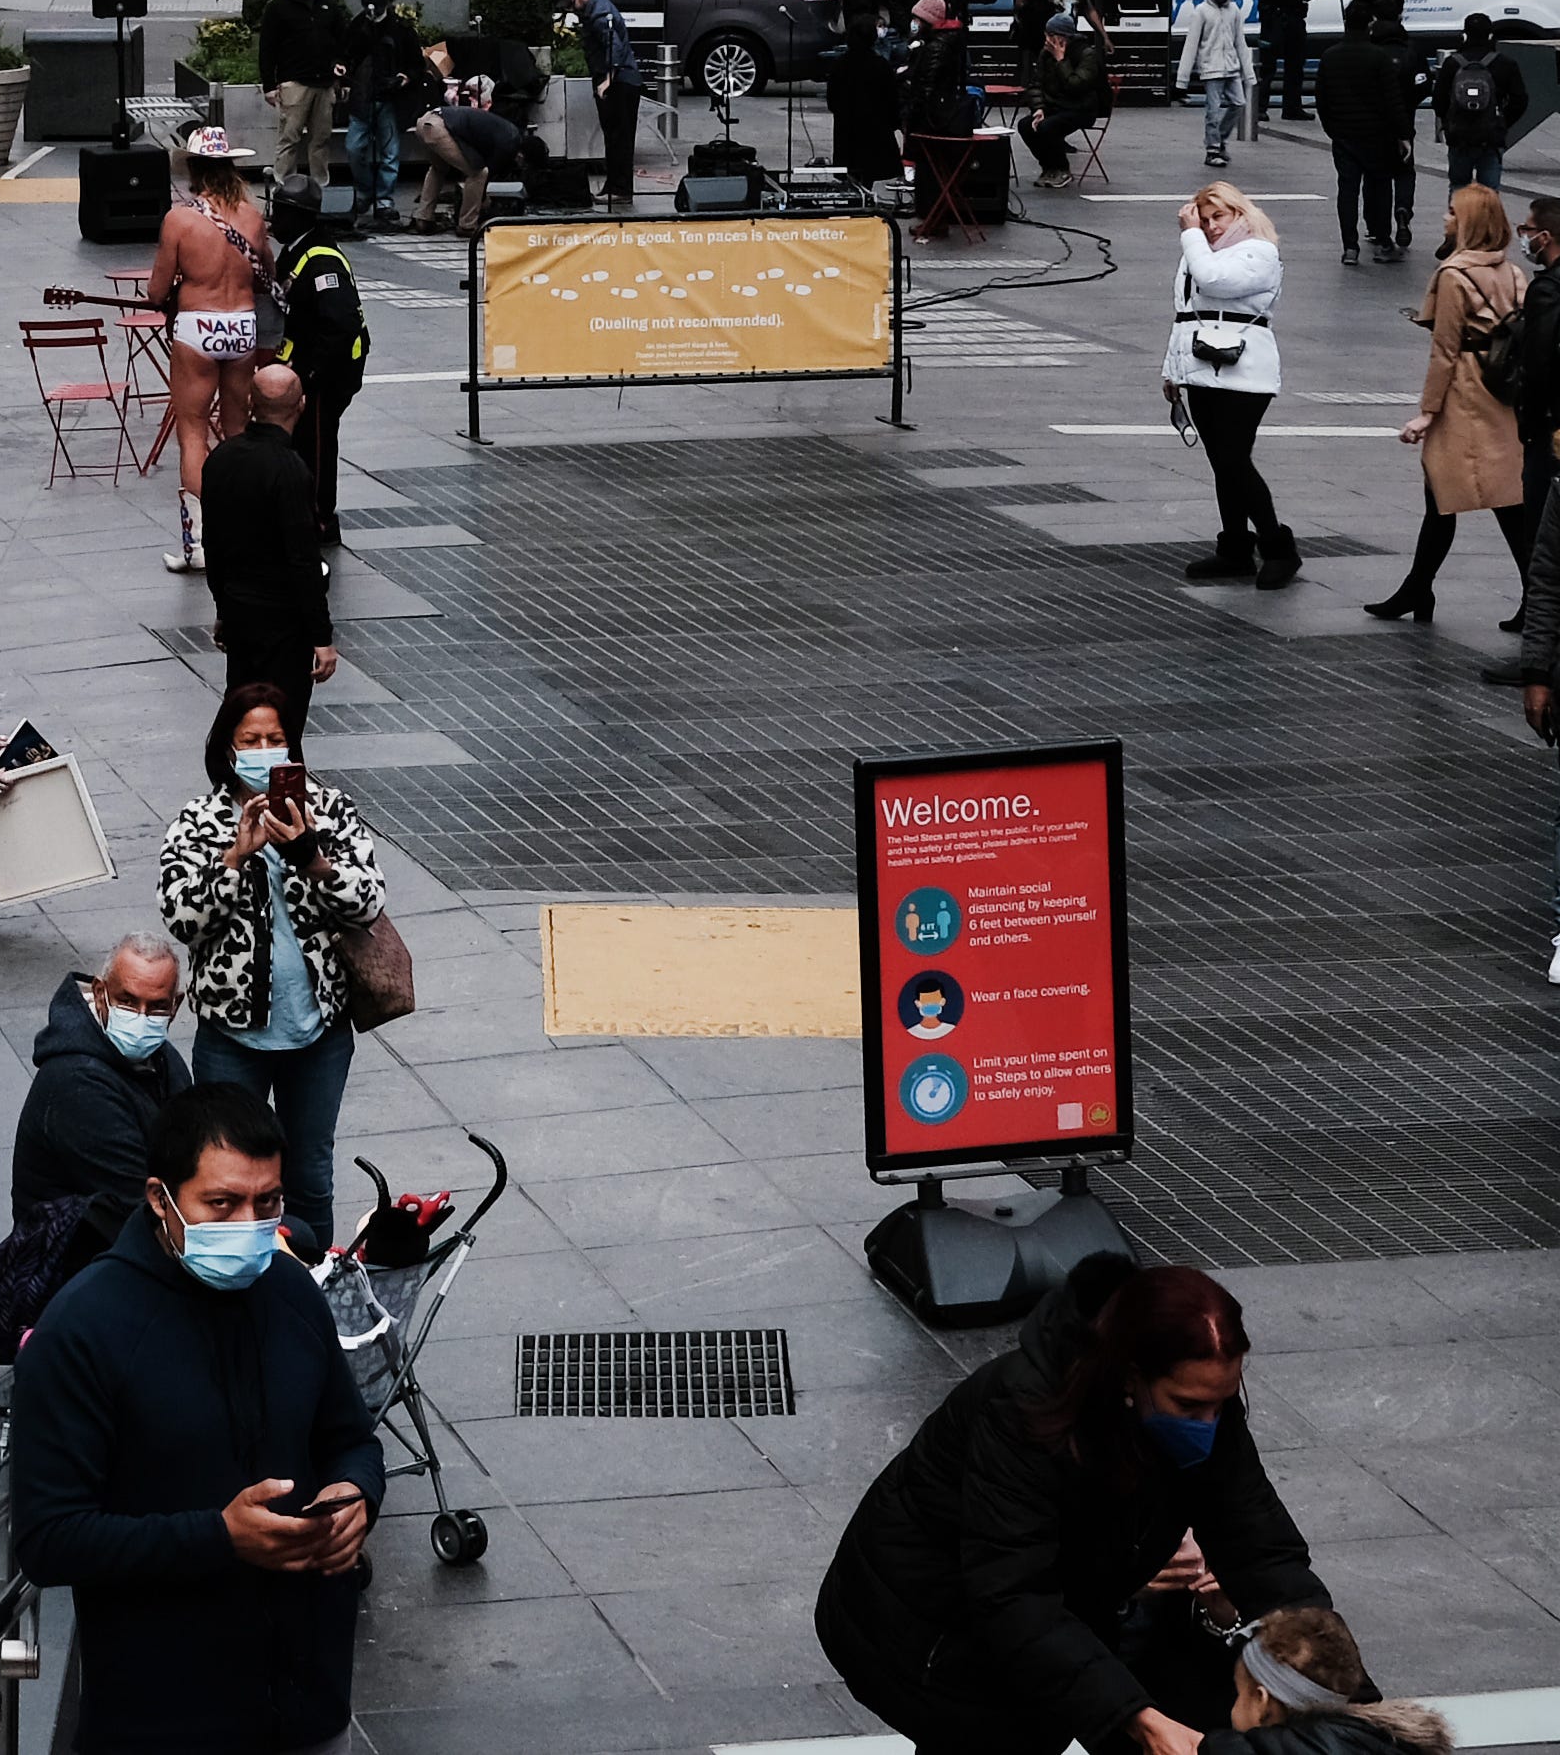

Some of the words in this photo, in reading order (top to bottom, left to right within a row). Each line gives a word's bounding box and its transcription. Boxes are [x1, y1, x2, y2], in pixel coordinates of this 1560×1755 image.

[528, 234, 549, 247] Six
[552, 233, 580, 246] feet
[583, 233, 618, 247] away
[621, 231, 634, 244] is
[637, 231, 676, 247] good.
[680, 230, 703, 243] Ten
[707, 231, 748, 245] paces
[751, 229, 763, 242] is
[766, 231, 798, 242] even
[803, 228, 847, 242] better.
[589, 317, 648, 333] (Dueling
[652, 316, 675, 329] not
[678, 313, 784, 330] recommended).
[881, 794, 1039, 828] Welcome.
[968, 885, 1016, 898] Maintain
[1019, 881, 1052, 894] social
[968, 899, 1026, 915] distancing
[1027, 899, 1040, 911] by
[1043, 895, 1087, 908] keeping
[969, 919, 977, 930] 6
[980, 917, 1001, 929] feet
[1004, 912, 1051, 928] between
[1053, 909, 1097, 925] yourself
[969, 934, 990, 947] and
[994, 931, 1032, 944] others.
[971, 991, 1000, 1003] Wear
[1003, 992, 1011, 1000] a
[1014, 987, 1037, 999] face
[1040, 983, 1091, 999] covering.
